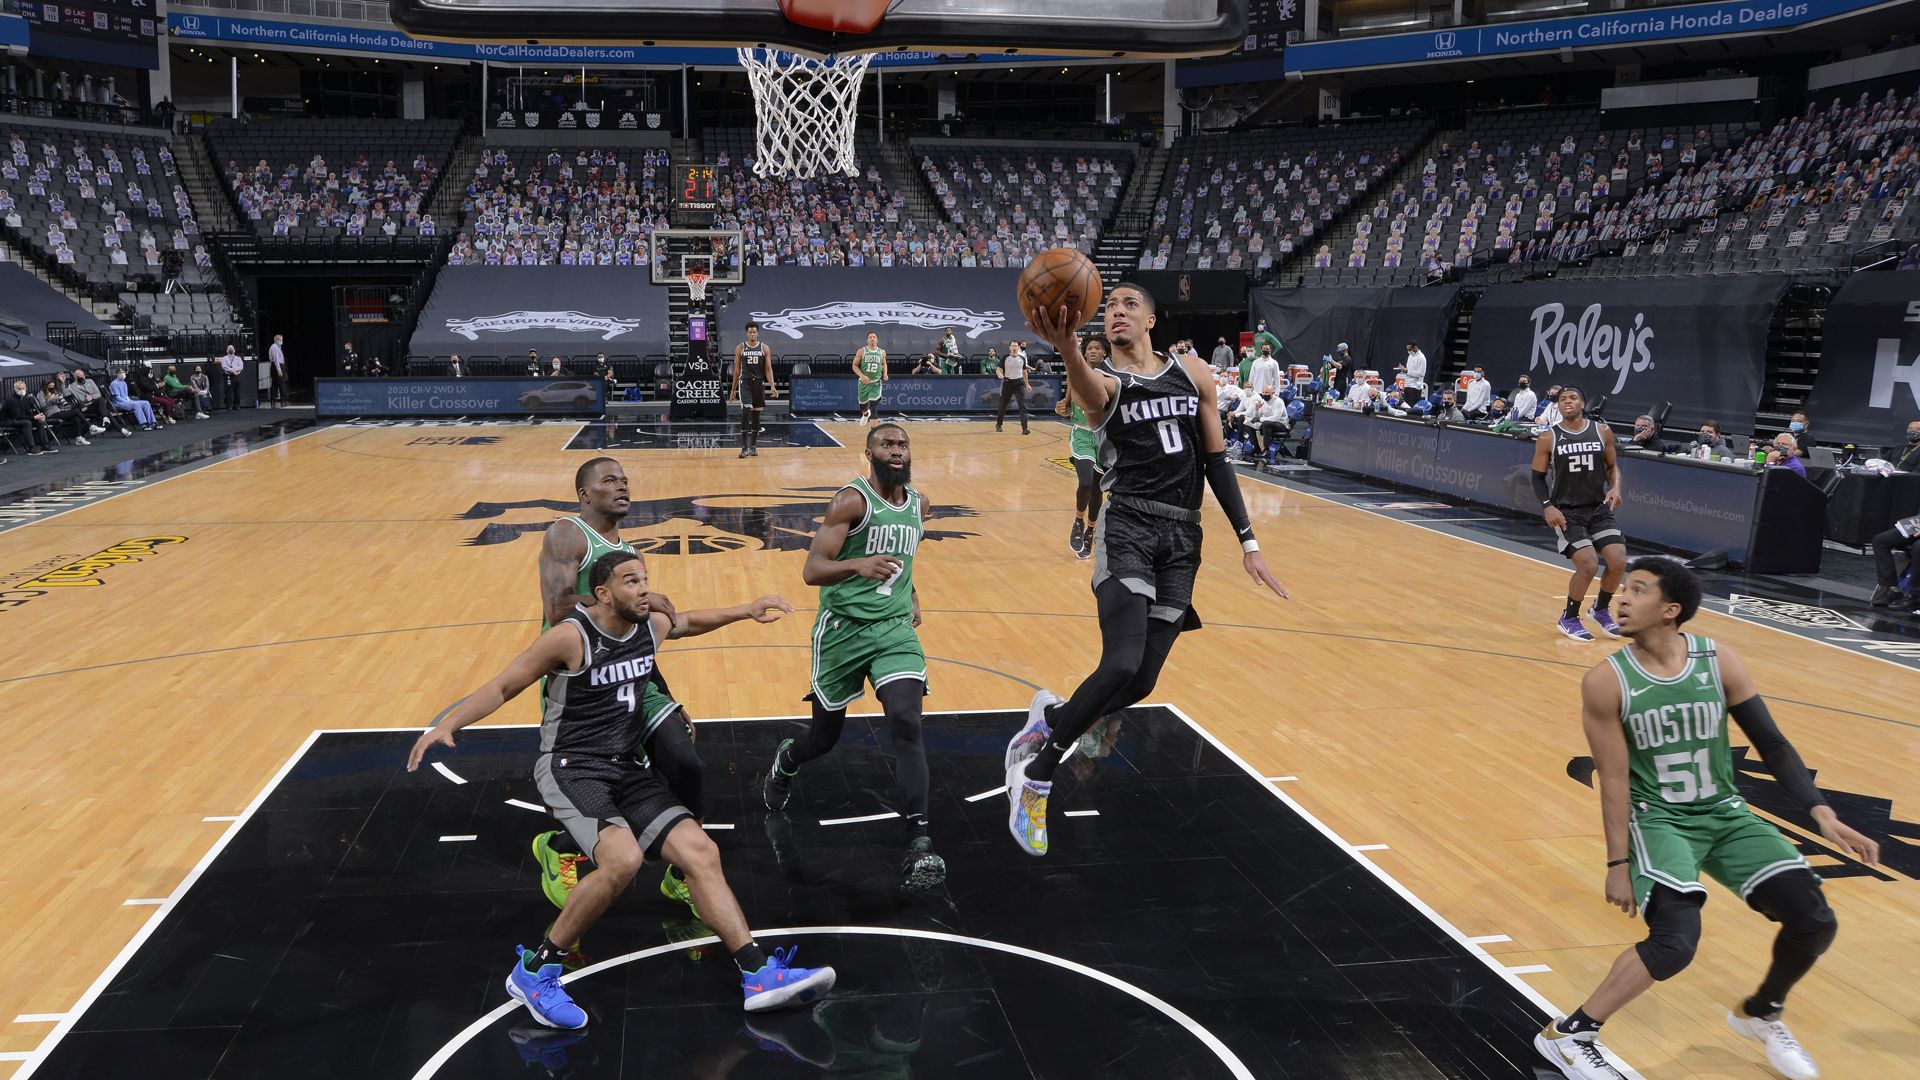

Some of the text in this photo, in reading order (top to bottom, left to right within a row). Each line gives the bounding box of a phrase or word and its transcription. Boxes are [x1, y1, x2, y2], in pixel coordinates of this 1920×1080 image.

[1496, 2, 1808, 46] Northern California Honda Dealers
[231, 24, 434, 50] Northern California Honda Dealers
[475, 44, 635, 58] NorCalHondaDealers.com
[1426, 50, 1463, 58] HONDA
[1324, 95, 1337, 109] 103
[688, 168, 713, 180] 2:14
[685, 180, 710, 199] 21
[472, 317, 613, 329] SIERRA NEVADA
[787, 310, 970, 324] SIERRA NEVADA
[1529, 302, 1654, 395] Raley's
[747, 356, 759, 365] 20
[864, 354, 881, 363] BOSTON
[866, 363, 878, 373] 12
[387, 385, 467, 394] 2020 CR-V 2WD LX
[676, 380, 720, 390] CACHE
[900, 383, 921, 391] 2WD
[922, 383, 933, 391] LX
[388, 395, 500, 409] Killer Crossover
[676, 389, 720, 399] CREEK
[896, 392, 964, 406] Crossover
[1120, 395, 1200, 424] KINGS
[1157, 418, 1184, 454] 0
[1378, 429, 1397, 444] 2020
[1397, 433, 1418, 448] CR-V
[1417, 437, 1438, 452] 2WD
[1440, 440, 1452, 453] LX
[1557, 441, 1602, 456] KINGS
[1375, 448, 1483, 491] Killer Crossover
[1568, 454, 1595, 473] 24
[1627, 489, 1745, 523] NorCalHondaDealers.com
[865, 524, 920, 557] BOSTON
[875, 560, 905, 596] 7
[590, 654, 654, 686] KINGS
[616, 682, 636, 713] 9
[1629, 701, 1722, 750] BOSTON
[1653, 747, 1718, 804] 51
